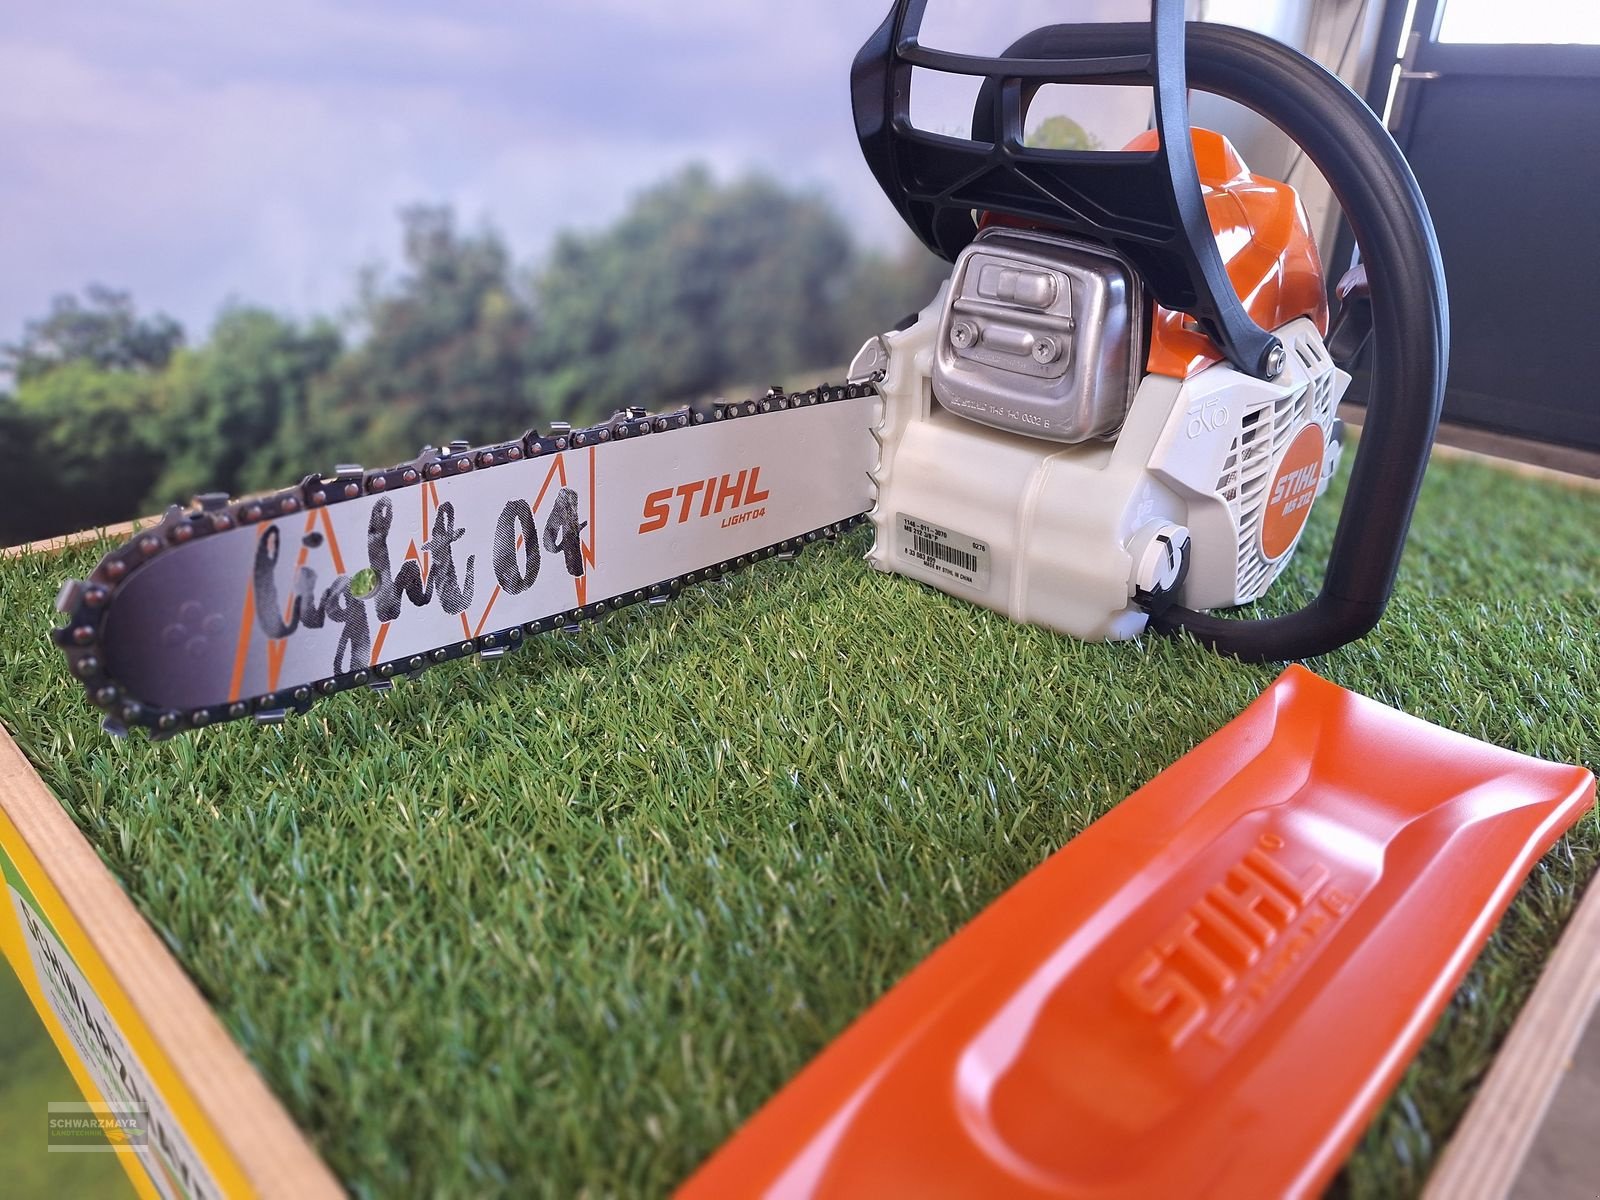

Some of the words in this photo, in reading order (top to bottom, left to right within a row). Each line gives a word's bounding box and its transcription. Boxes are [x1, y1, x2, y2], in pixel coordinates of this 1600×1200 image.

[638, 466, 770, 534] STIHL
[1270, 461, 1318, 505] STIHL
[254, 496, 475, 676] light
[493, 487, 588, 595] 04
[1114, 847, 1330, 1050] STIHL
